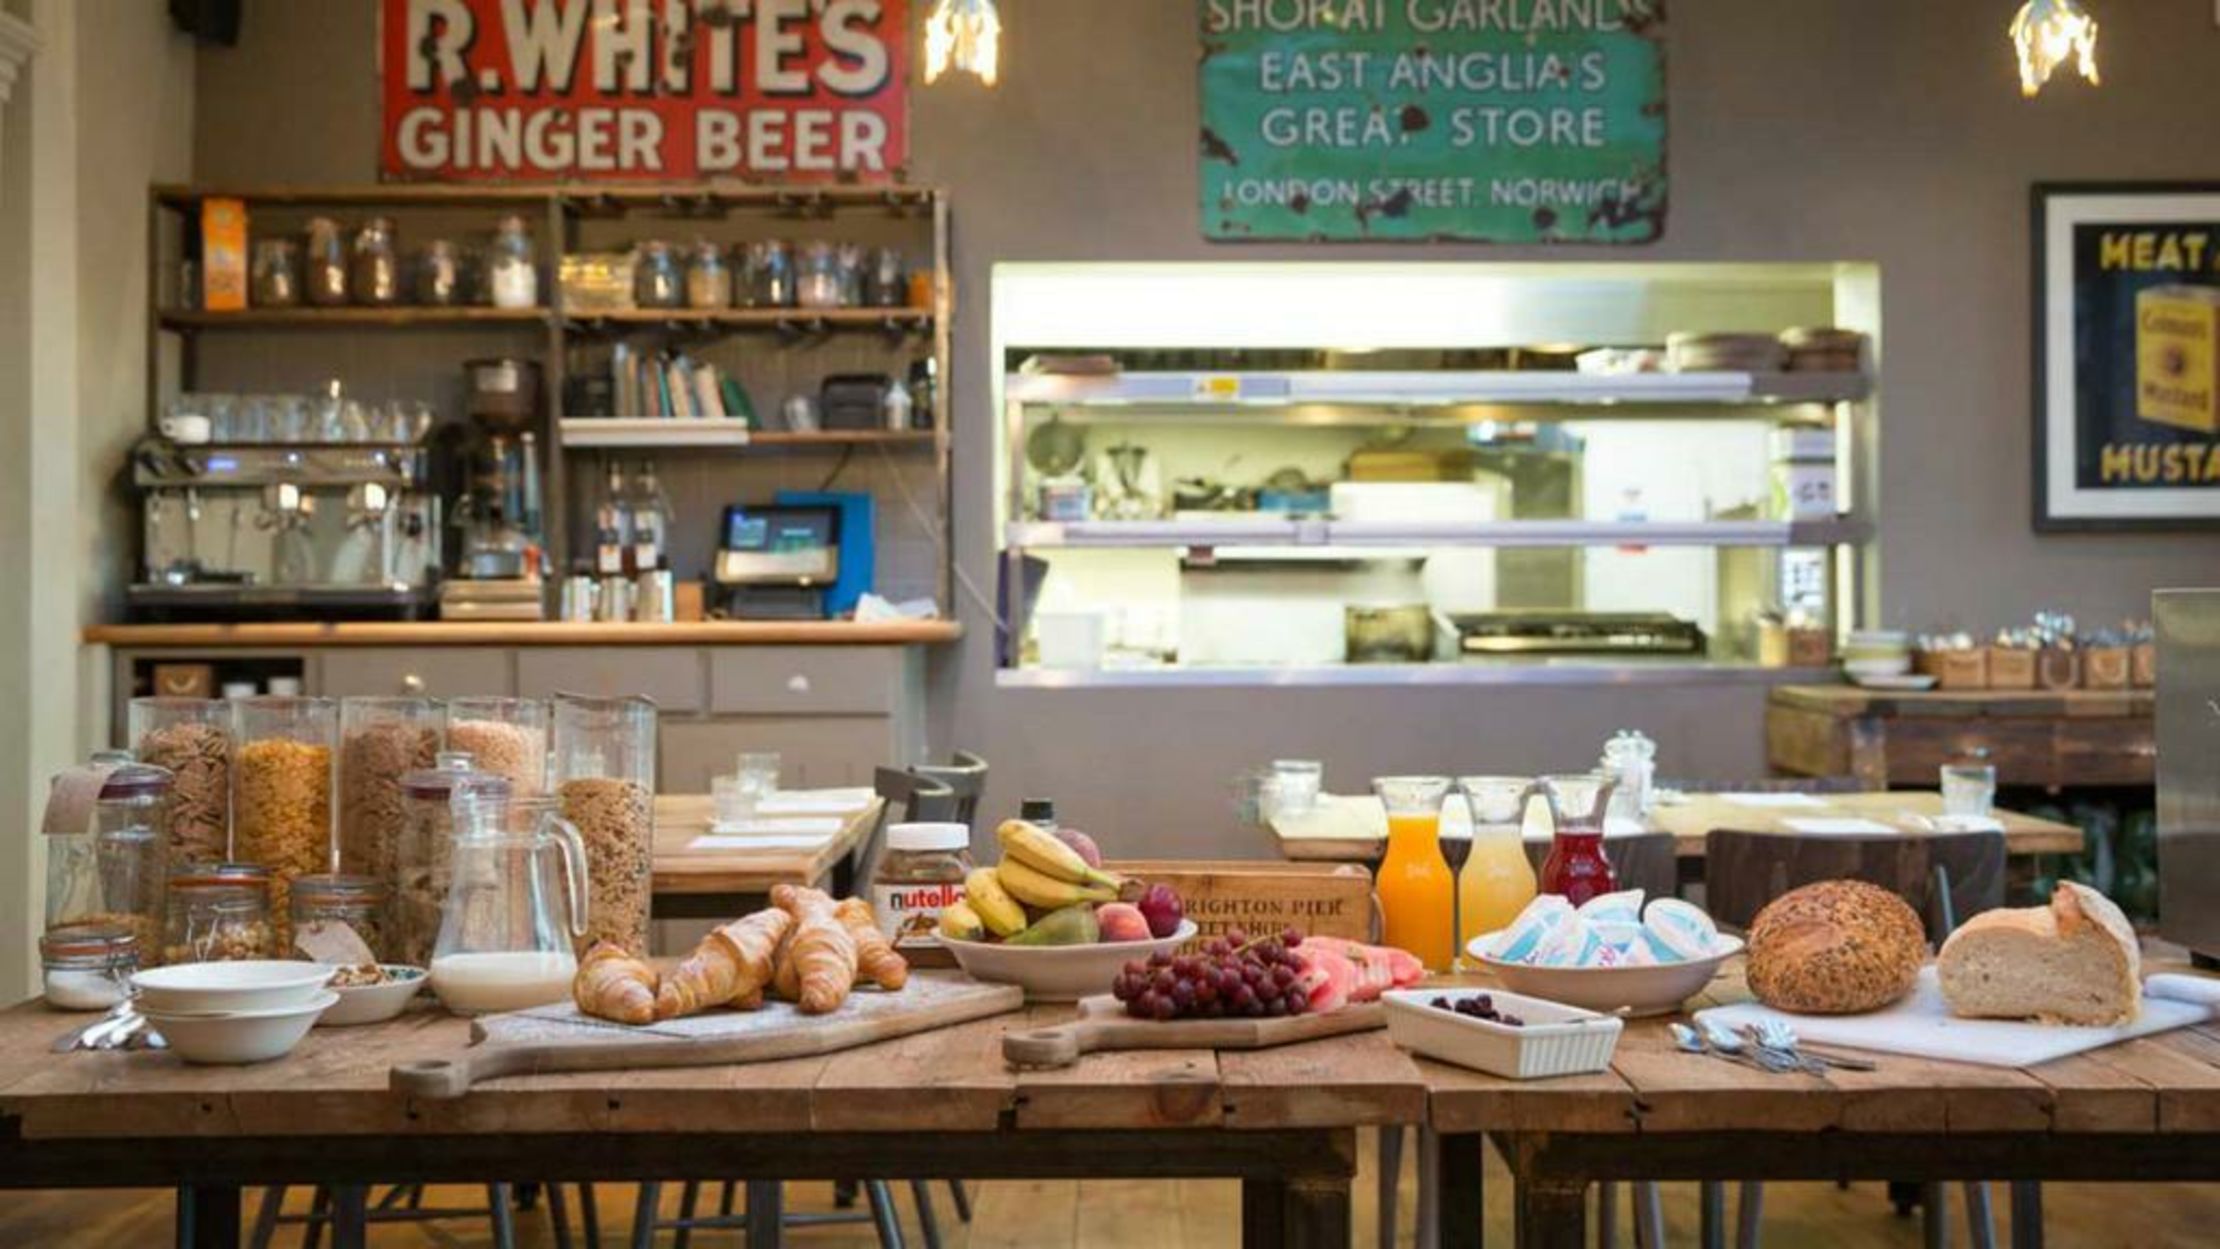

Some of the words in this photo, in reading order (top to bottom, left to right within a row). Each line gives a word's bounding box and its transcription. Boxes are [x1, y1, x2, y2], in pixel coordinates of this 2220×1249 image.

[1261, 52, 1371, 90] EAST
[397, 108, 664, 170] GINGER
[696, 109, 887, 170] BEER
[1452, 108, 1604, 147] STORE
[2101, 233, 2207, 270] MEAT
[1293, 899, 1345, 916] PIER
